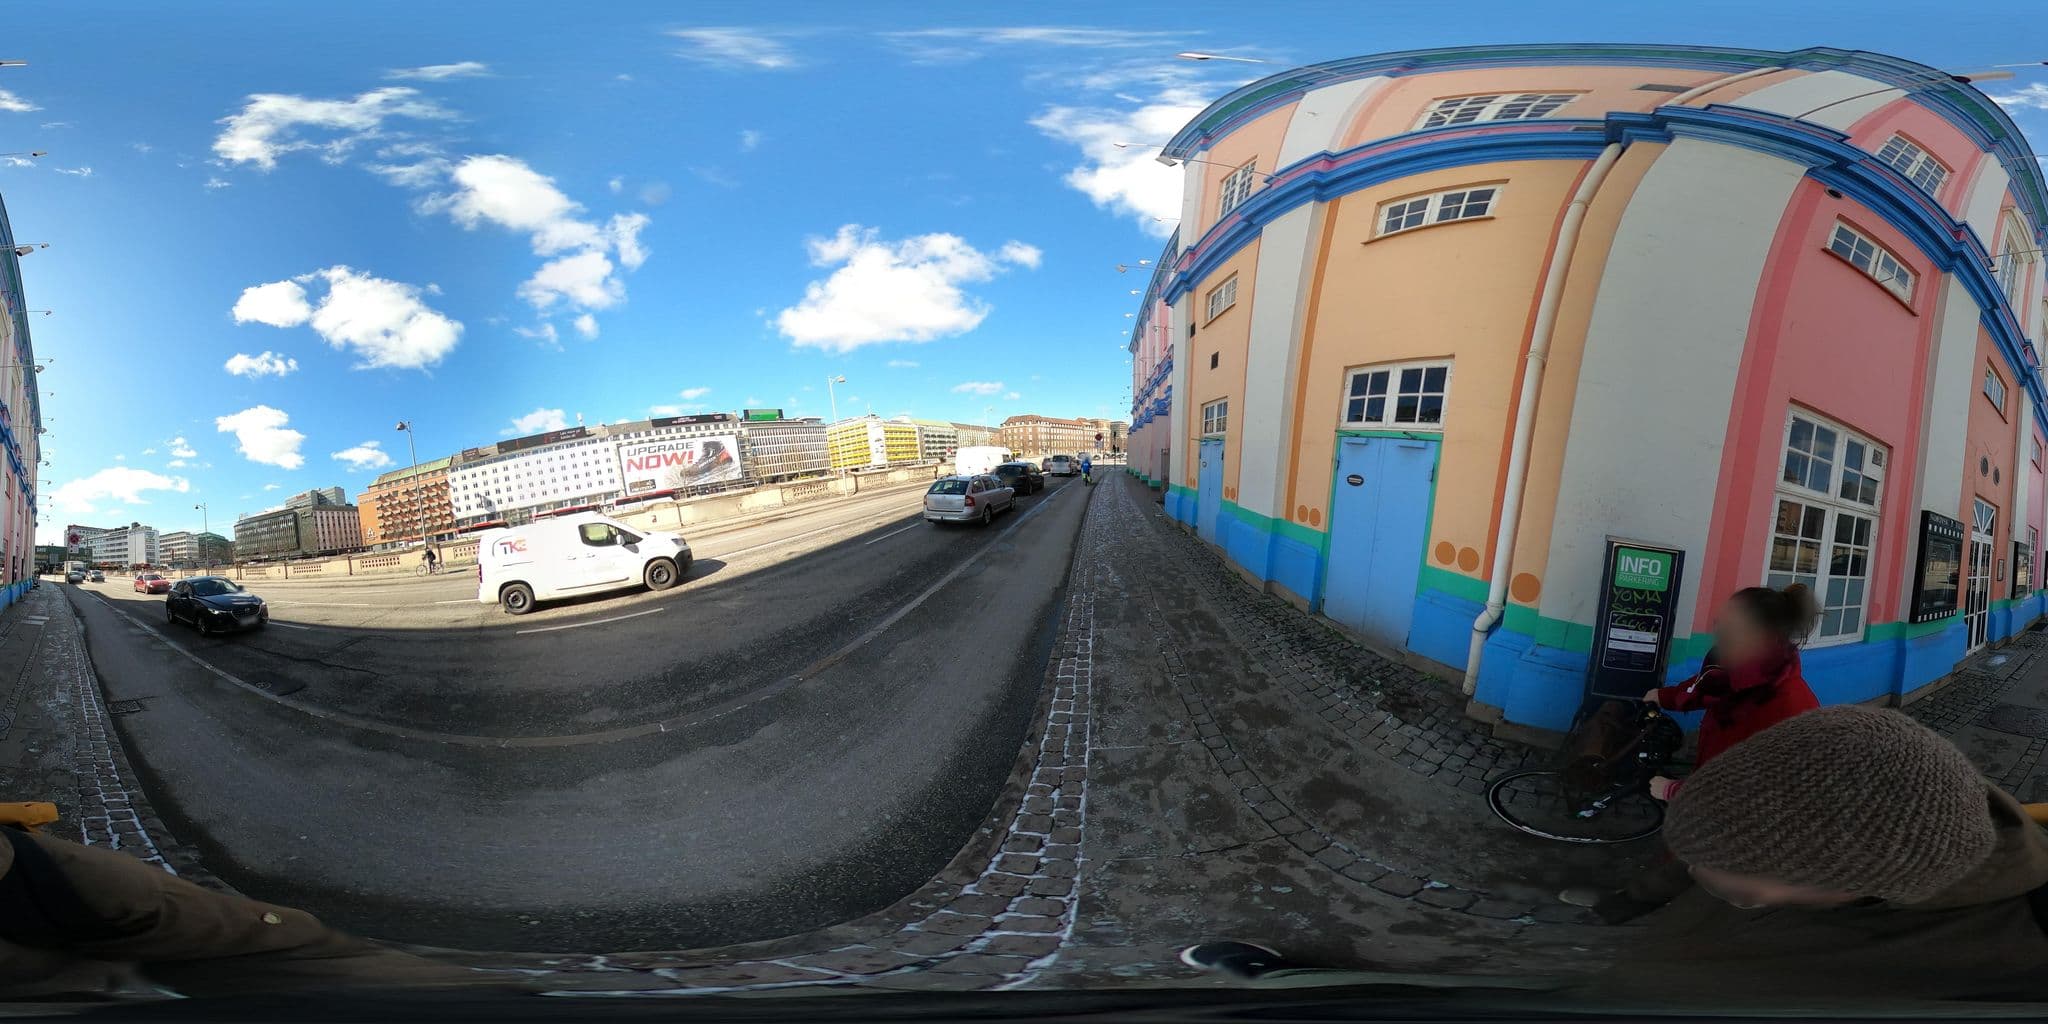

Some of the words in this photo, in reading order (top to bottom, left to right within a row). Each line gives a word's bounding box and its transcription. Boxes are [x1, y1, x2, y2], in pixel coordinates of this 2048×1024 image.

[627, 442, 694, 456] UPGRADE
[627, 450, 694, 472] NOW!
[1620, 555, 1661, 575] INFO
